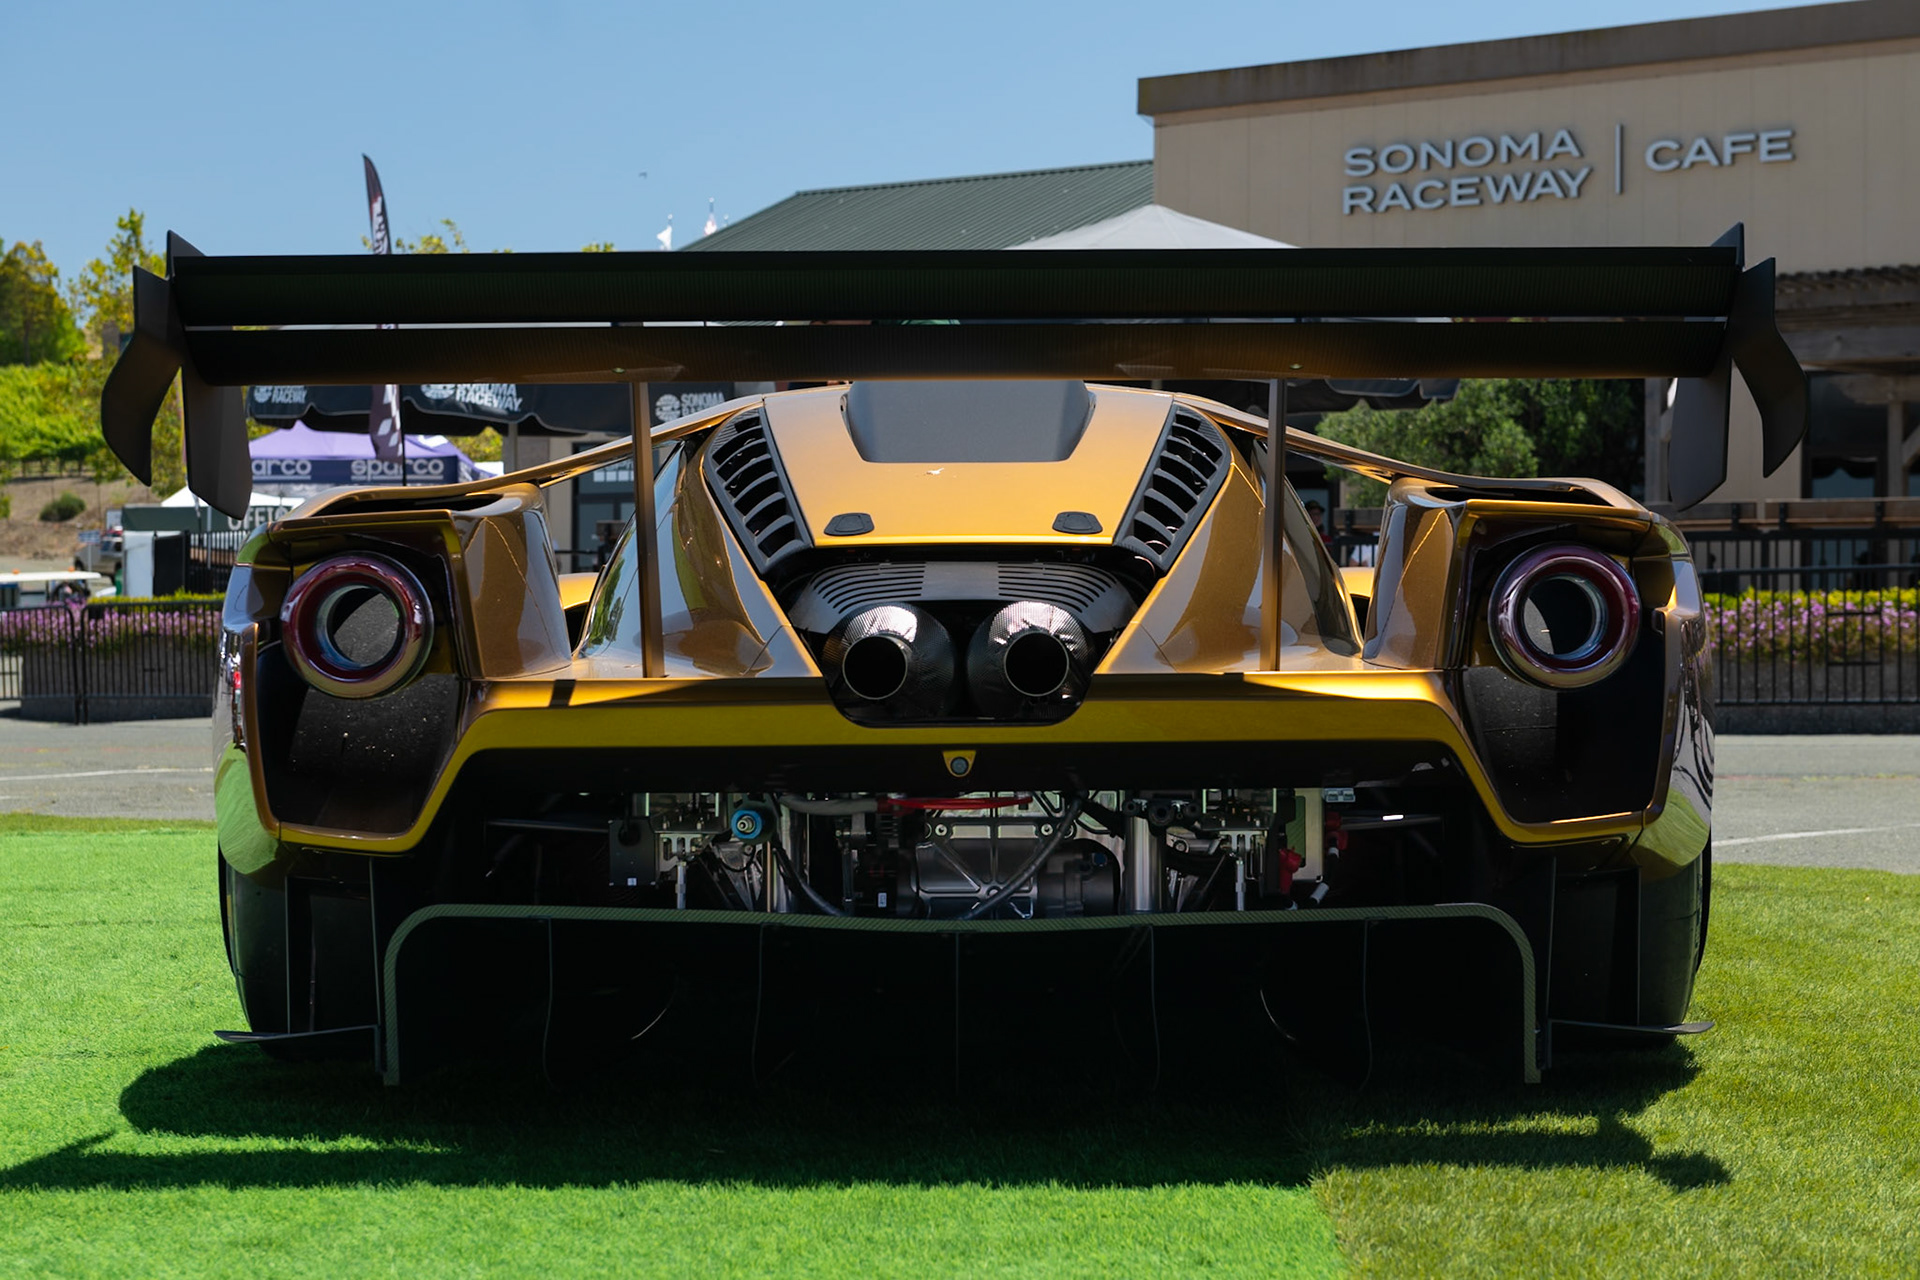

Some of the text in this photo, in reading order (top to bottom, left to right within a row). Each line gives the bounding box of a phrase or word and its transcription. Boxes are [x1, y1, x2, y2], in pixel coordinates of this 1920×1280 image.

[1344, 129, 1582, 177] SONOMA
[1645, 129, 1795, 172] CAFE
[1342, 166, 1592, 215] RACEWAY
[456, 387, 522, 412] RACEWAY
[251, 459, 312, 475] arco
